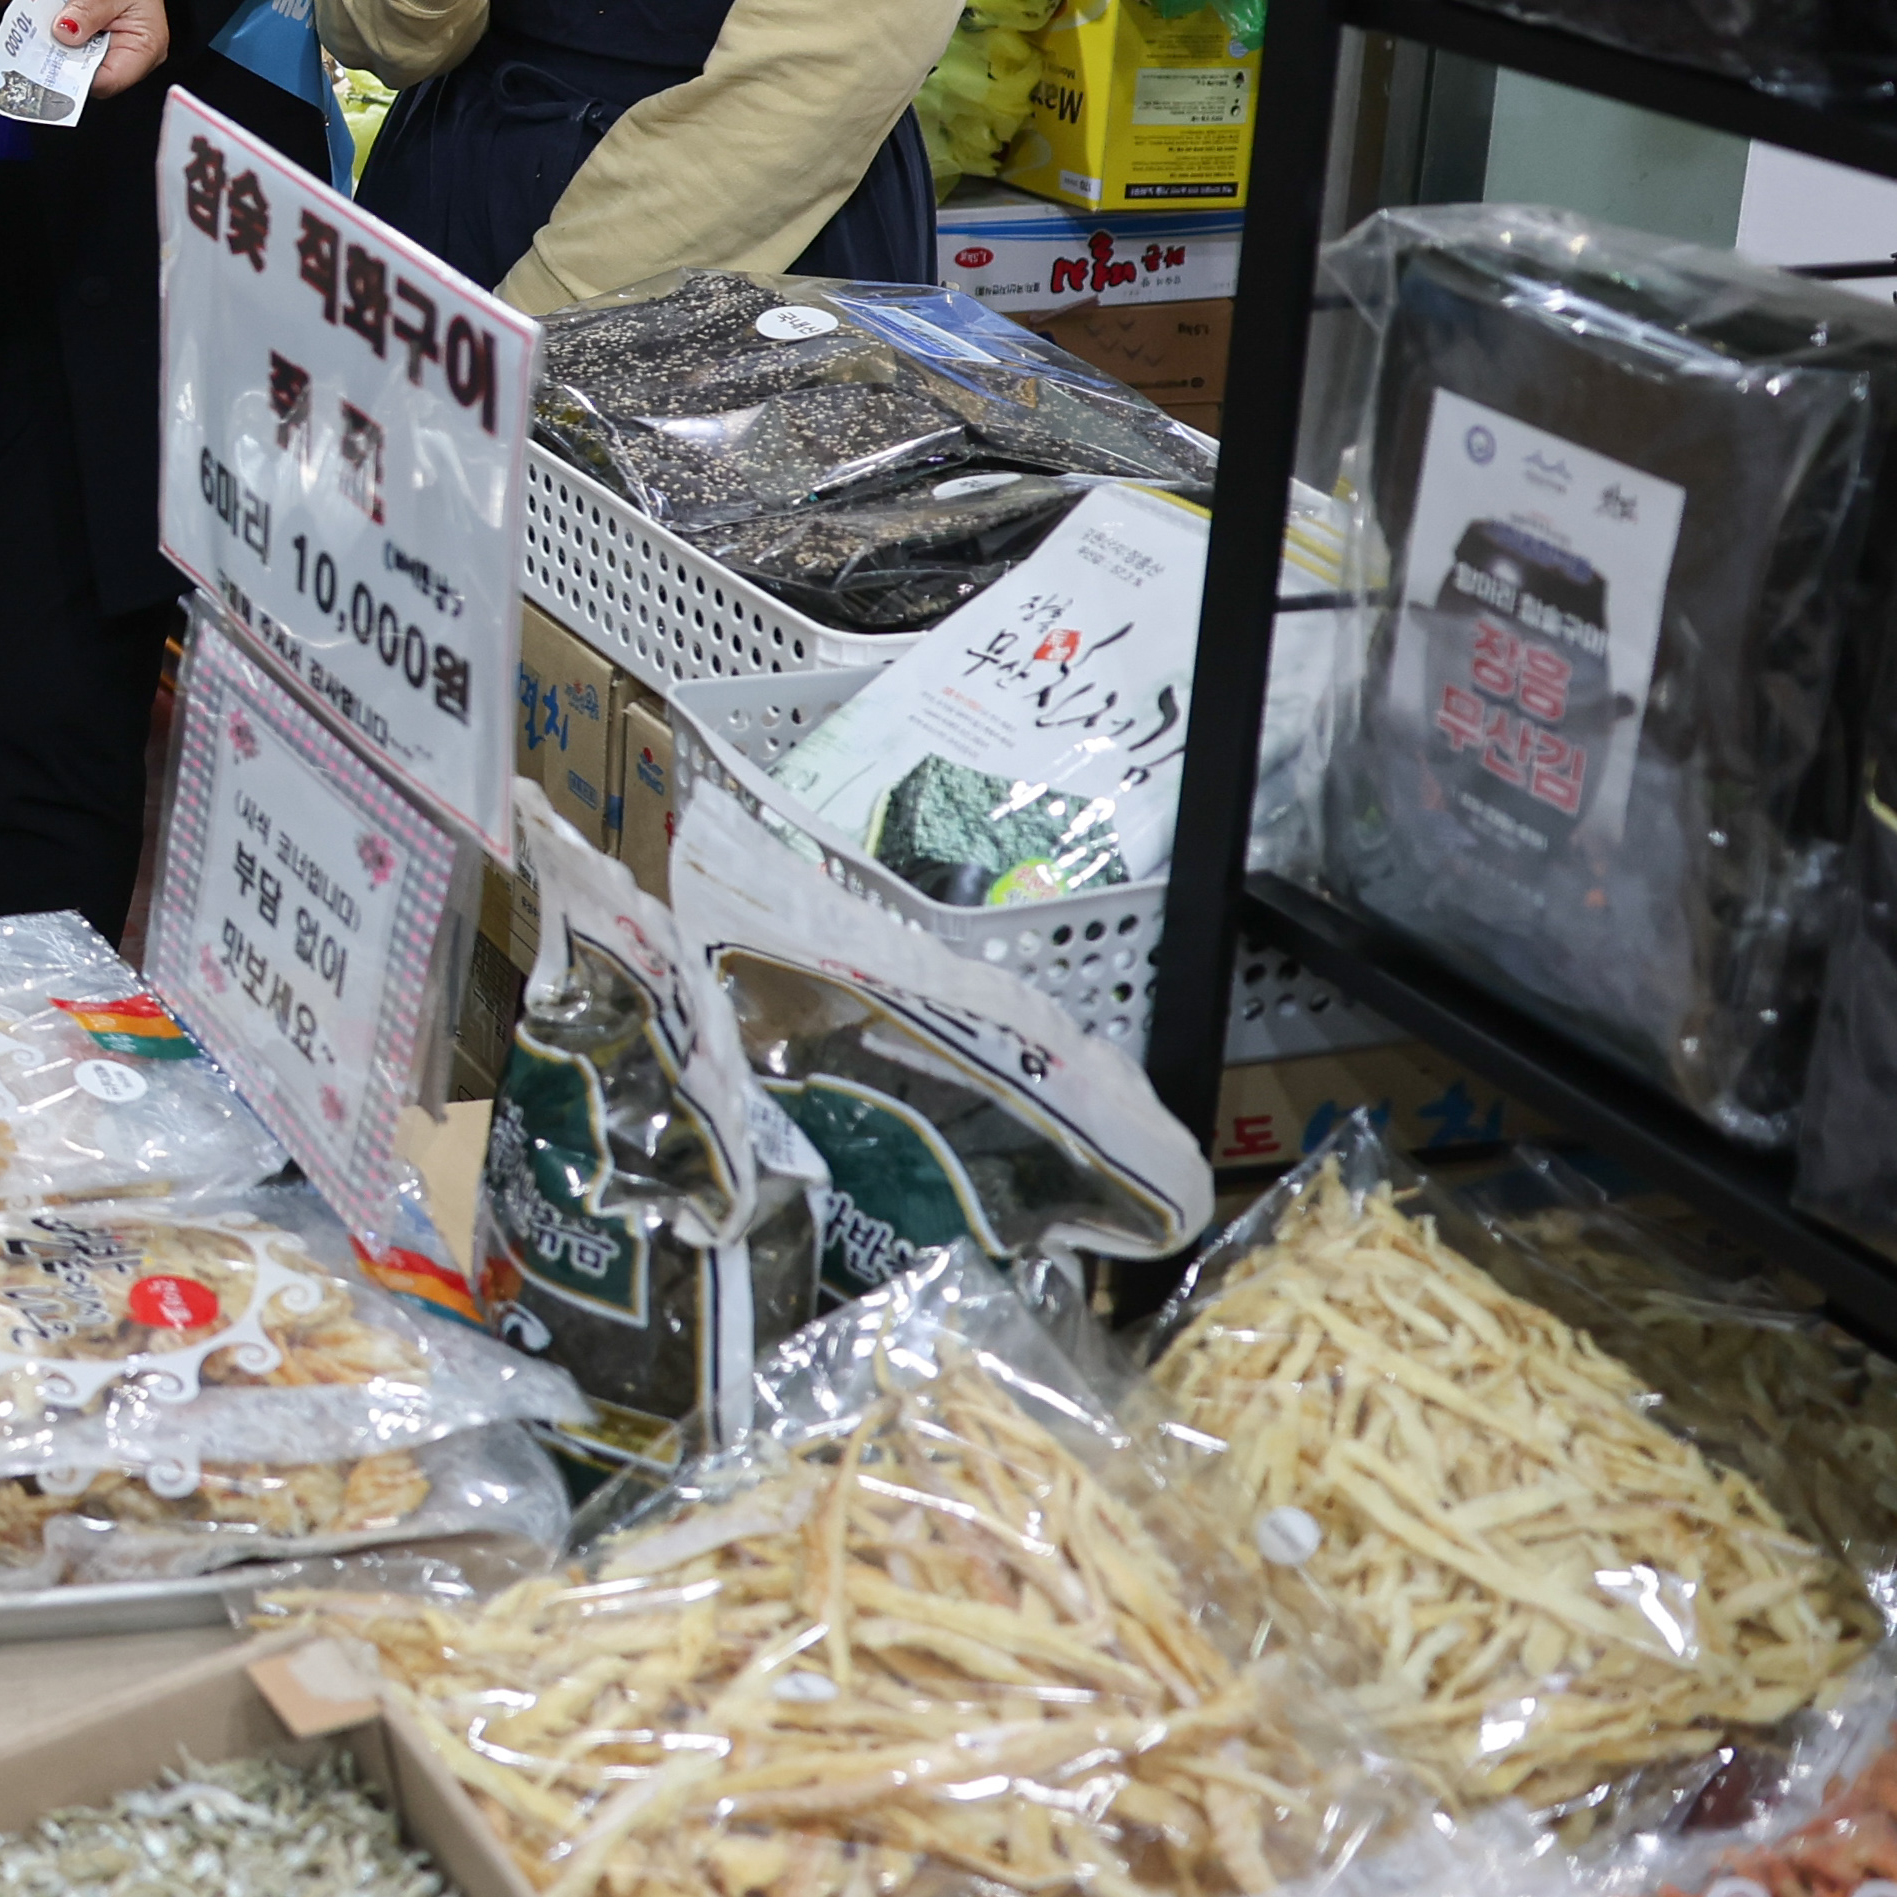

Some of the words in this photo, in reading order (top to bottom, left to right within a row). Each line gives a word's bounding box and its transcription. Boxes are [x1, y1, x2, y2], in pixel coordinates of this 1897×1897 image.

[4, 9, 33, 59] 10,000
[183, 135, 271, 273] 참숯
[295, 206, 498, 437] 직화구이
[1050, 230, 1137, 293] 멸치
[199, 445, 273, 566] 6마리
[293, 534, 473, 727] 10,000원
[1435, 682, 1587, 814] 무산김
[233, 840, 283, 929] 부담
[295, 906, 348, 999] 없이
[277, 831, 362, 934] 코너입니다)
